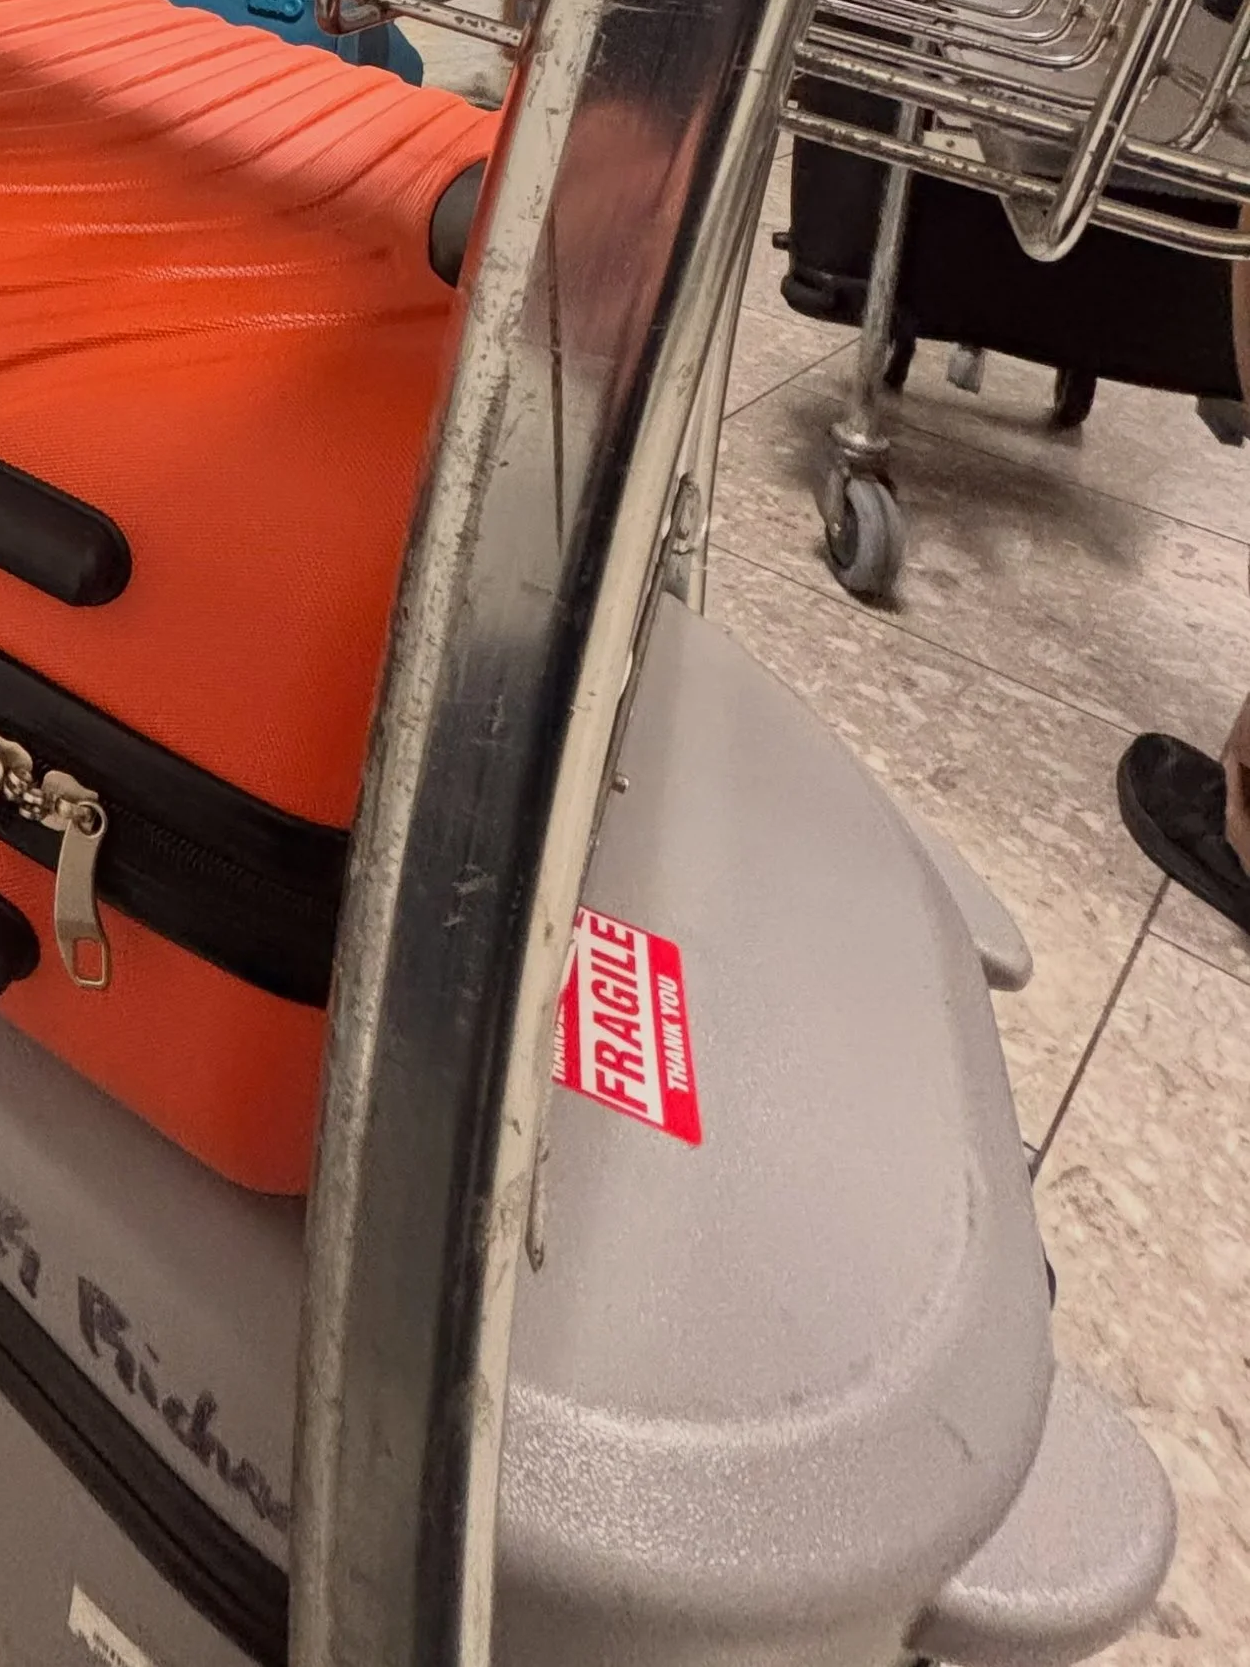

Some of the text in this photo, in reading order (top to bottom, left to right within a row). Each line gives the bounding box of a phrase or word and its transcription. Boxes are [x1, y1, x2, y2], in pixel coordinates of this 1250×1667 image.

[589, 915, 649, 1115] FRAGILE
[656, 974, 690, 1093] THANK YOU
